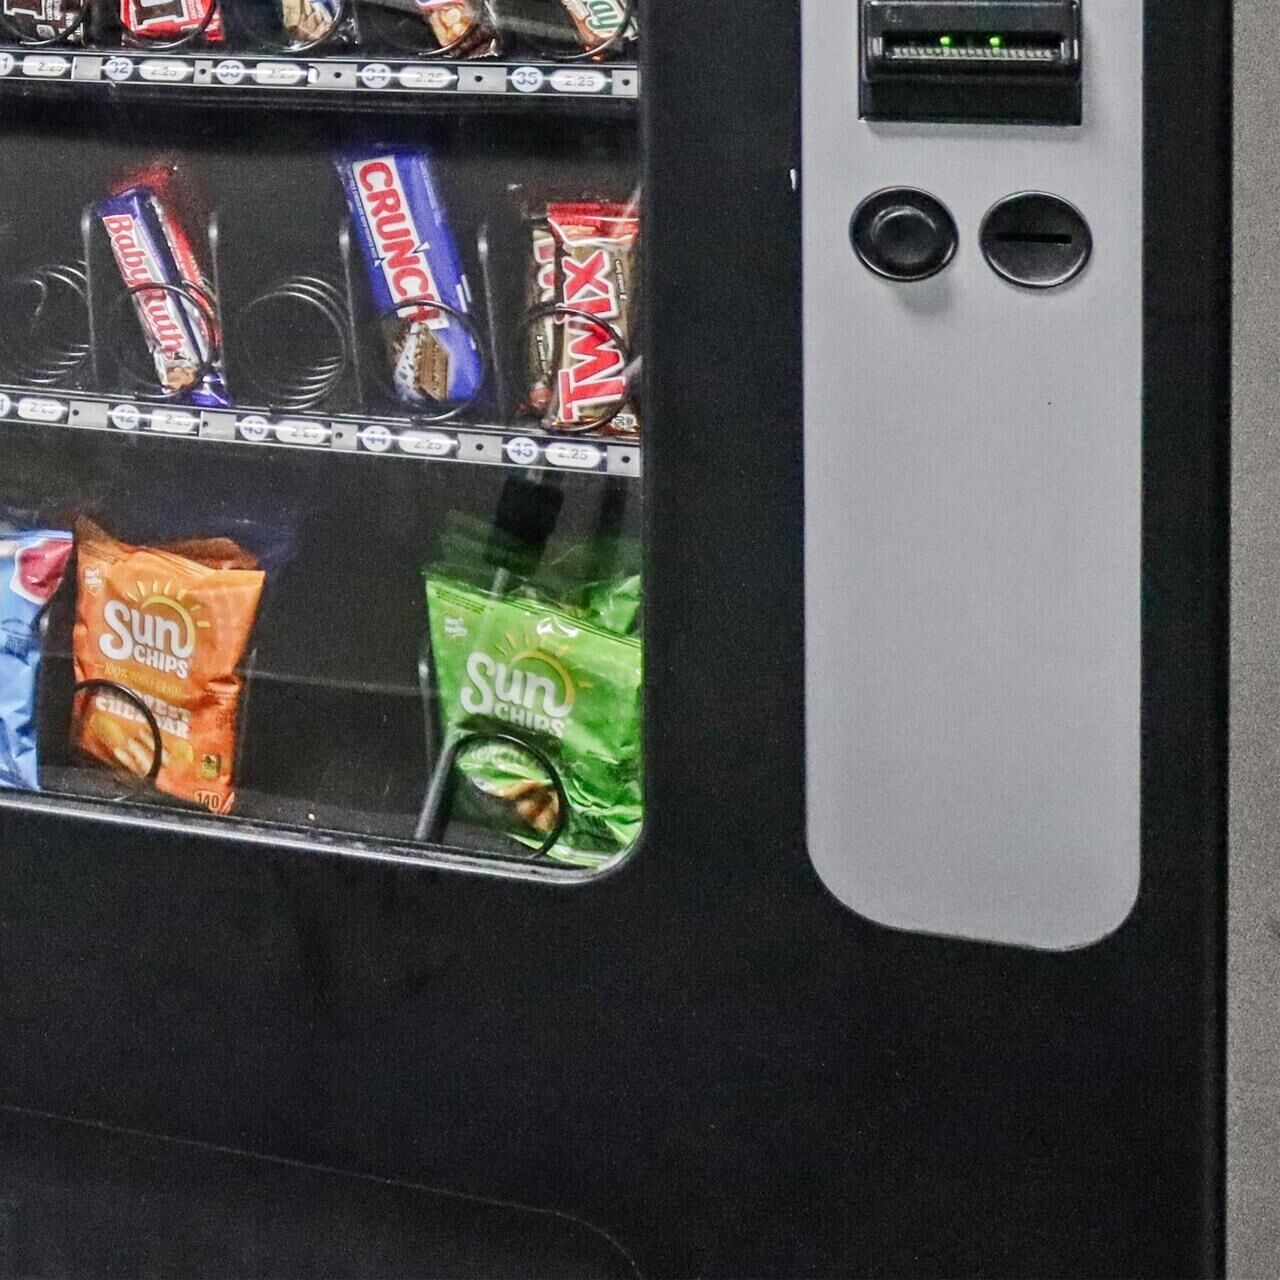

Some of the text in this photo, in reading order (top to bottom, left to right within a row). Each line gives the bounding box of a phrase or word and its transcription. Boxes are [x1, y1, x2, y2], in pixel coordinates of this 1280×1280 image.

[516, 71, 538, 85] 35
[104, 216, 154, 288] Baby
[359, 161, 439, 323] CRUNCH
[559, 250, 626, 421] TWIX
[98, 599, 193, 660] Sun
[133, 644, 188, 679] CHIPS
[460, 651, 568, 717] Sun
[495, 702, 565, 738] CHIPS
